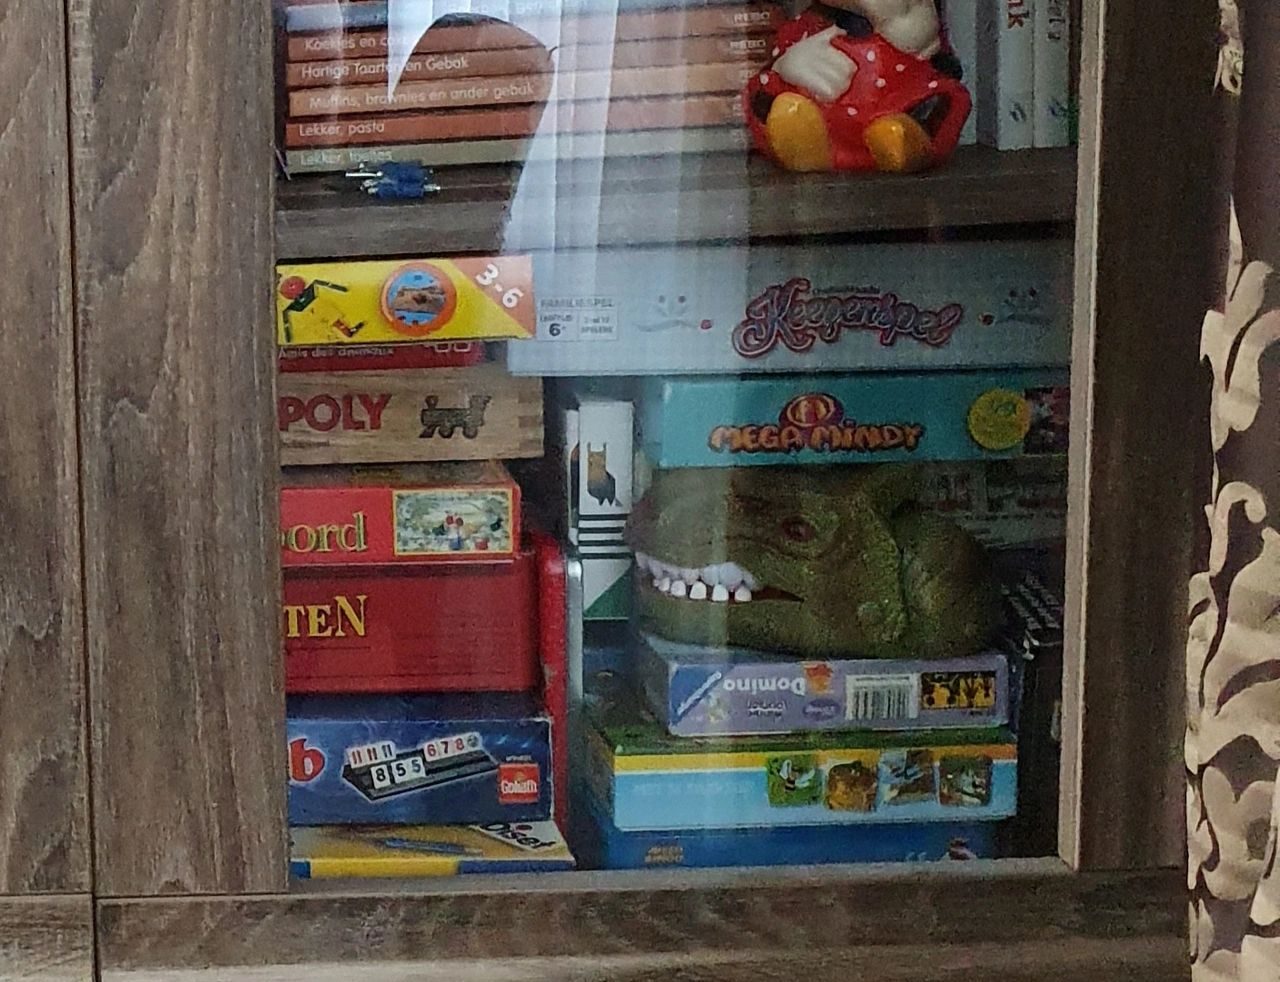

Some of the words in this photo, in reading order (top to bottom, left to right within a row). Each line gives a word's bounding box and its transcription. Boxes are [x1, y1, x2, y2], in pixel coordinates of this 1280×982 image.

[359, 36, 376, 48] en
[301, 63, 350, 80] Hartige
[425, 55, 469, 71] Gebak
[428, 90, 446, 101] en
[450, 84, 489, 100] ander
[493, 82, 534, 100] gebak
[348, 121, 385, 139] pasta
[277, 392, 393, 432] POLY
[709, 424, 806, 453] MEGA
[280, 510, 368, 555] ord
[722, 676, 807, 698] Domino
